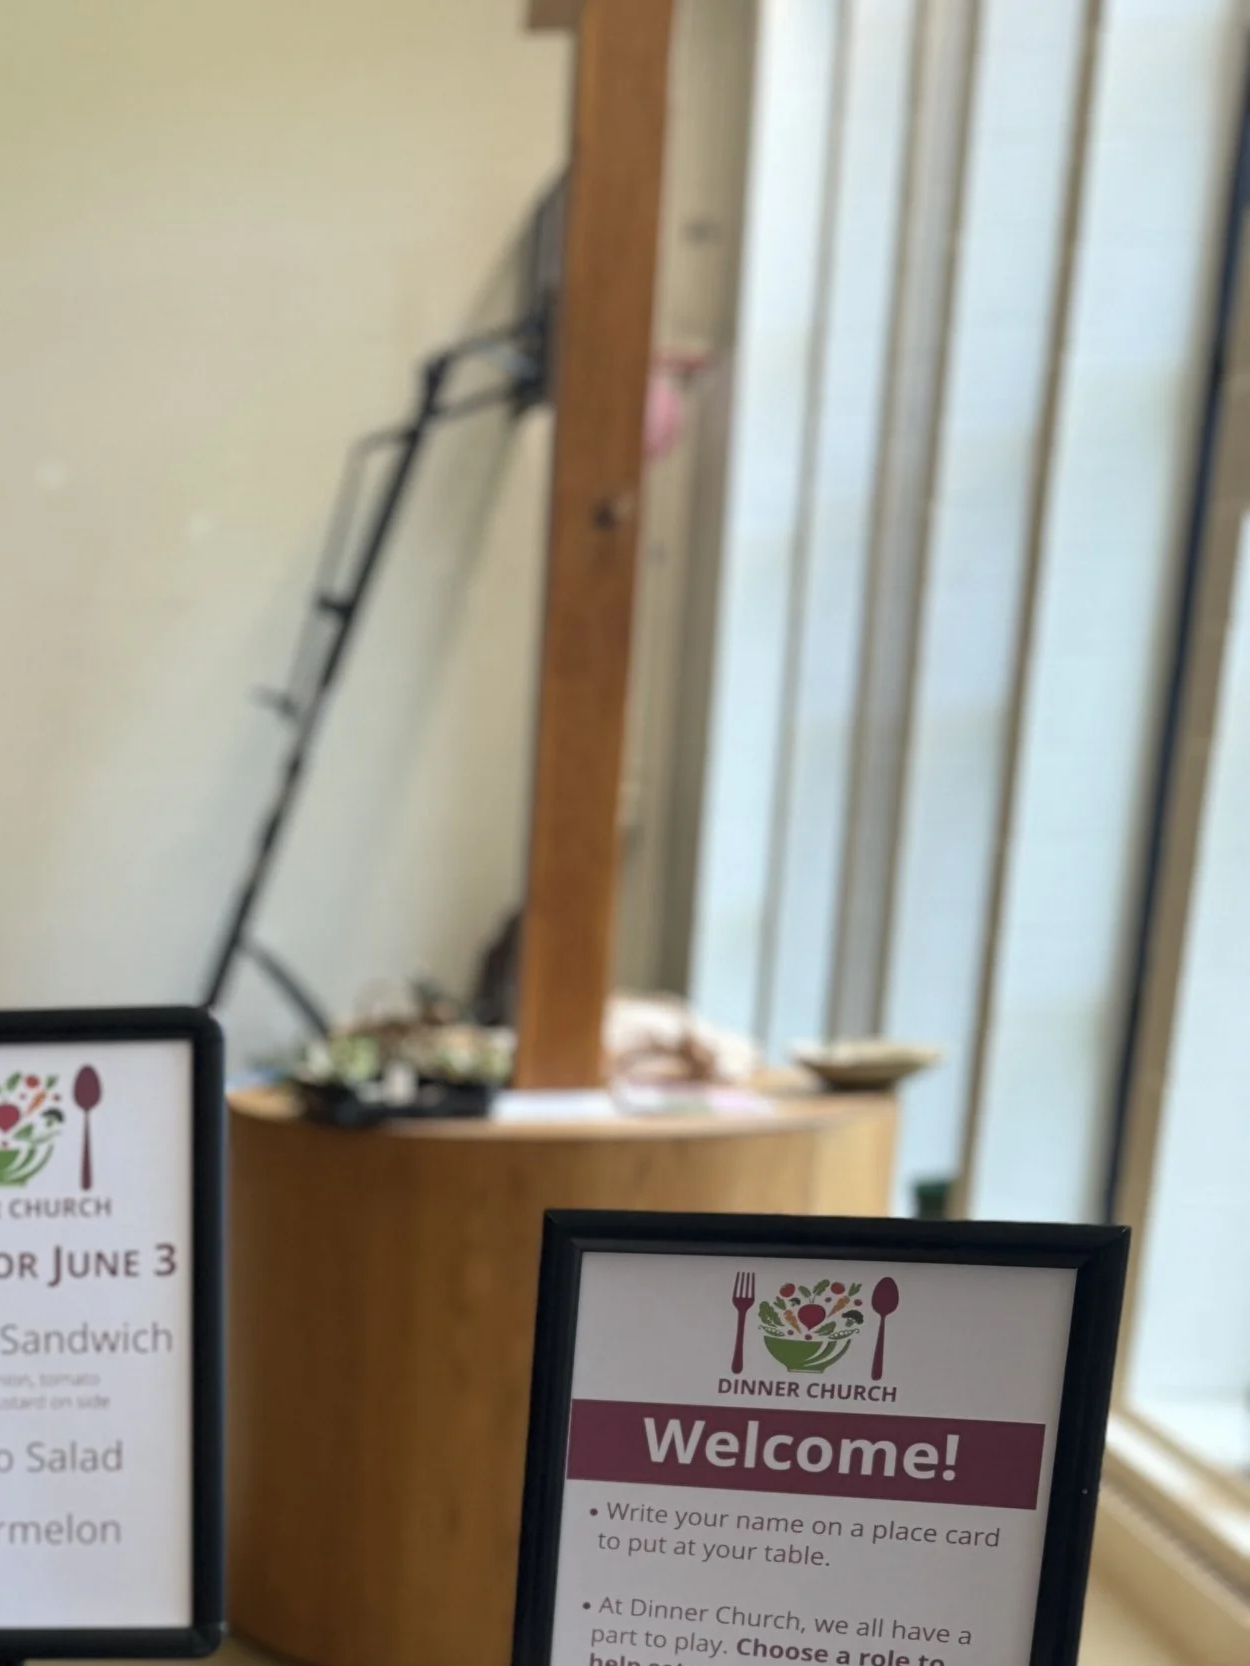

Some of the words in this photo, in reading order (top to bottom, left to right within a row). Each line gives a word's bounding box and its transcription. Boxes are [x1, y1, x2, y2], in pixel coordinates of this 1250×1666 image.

[8, 1197, 111, 1219] CHURCH
[154, 1242, 178, 1277] 3
[0, 1321, 174, 1356] Sandwich
[717, 1378, 799, 1398] DINNER
[806, 1382, 897, 1402] CHURCH
[26, 1439, 123, 1473] Salad
[643, 1416, 959, 1481] Welcome!
[607, 1502, 668, 1524] Write
[673, 1510, 729, 1530] your
[736, 1515, 804, 1533] name
[812, 1520, 842, 1536] on
[850, 1522, 864, 1538] a
[872, 1520, 937, 1544] place
[945, 1527, 1001, 1548] card
[598, 1533, 620, 1550] to
[628, 1537, 667, 1557] put
[673, 1539, 696, 1556] at
[701, 1543, 758, 1562] your
[764, 1543, 830, 1567] table.
[599, 1596, 622, 1615] At
[630, 1598, 709, 1622] Dinner
[715, 1605, 805, 1634] Church,
[814, 1618, 849, 1635] we
[856, 1617, 884, 1638] all
[892, 1619, 950, 1644] have
[957, 1630, 972, 1646] a
[591, 1629, 637, 1646] part
[645, 1631, 666, 1648] to
[675, 1632, 727, 1658] play.
[736, 1637, 829, 1663] Choose
[835, 1650, 850, 1665] a
